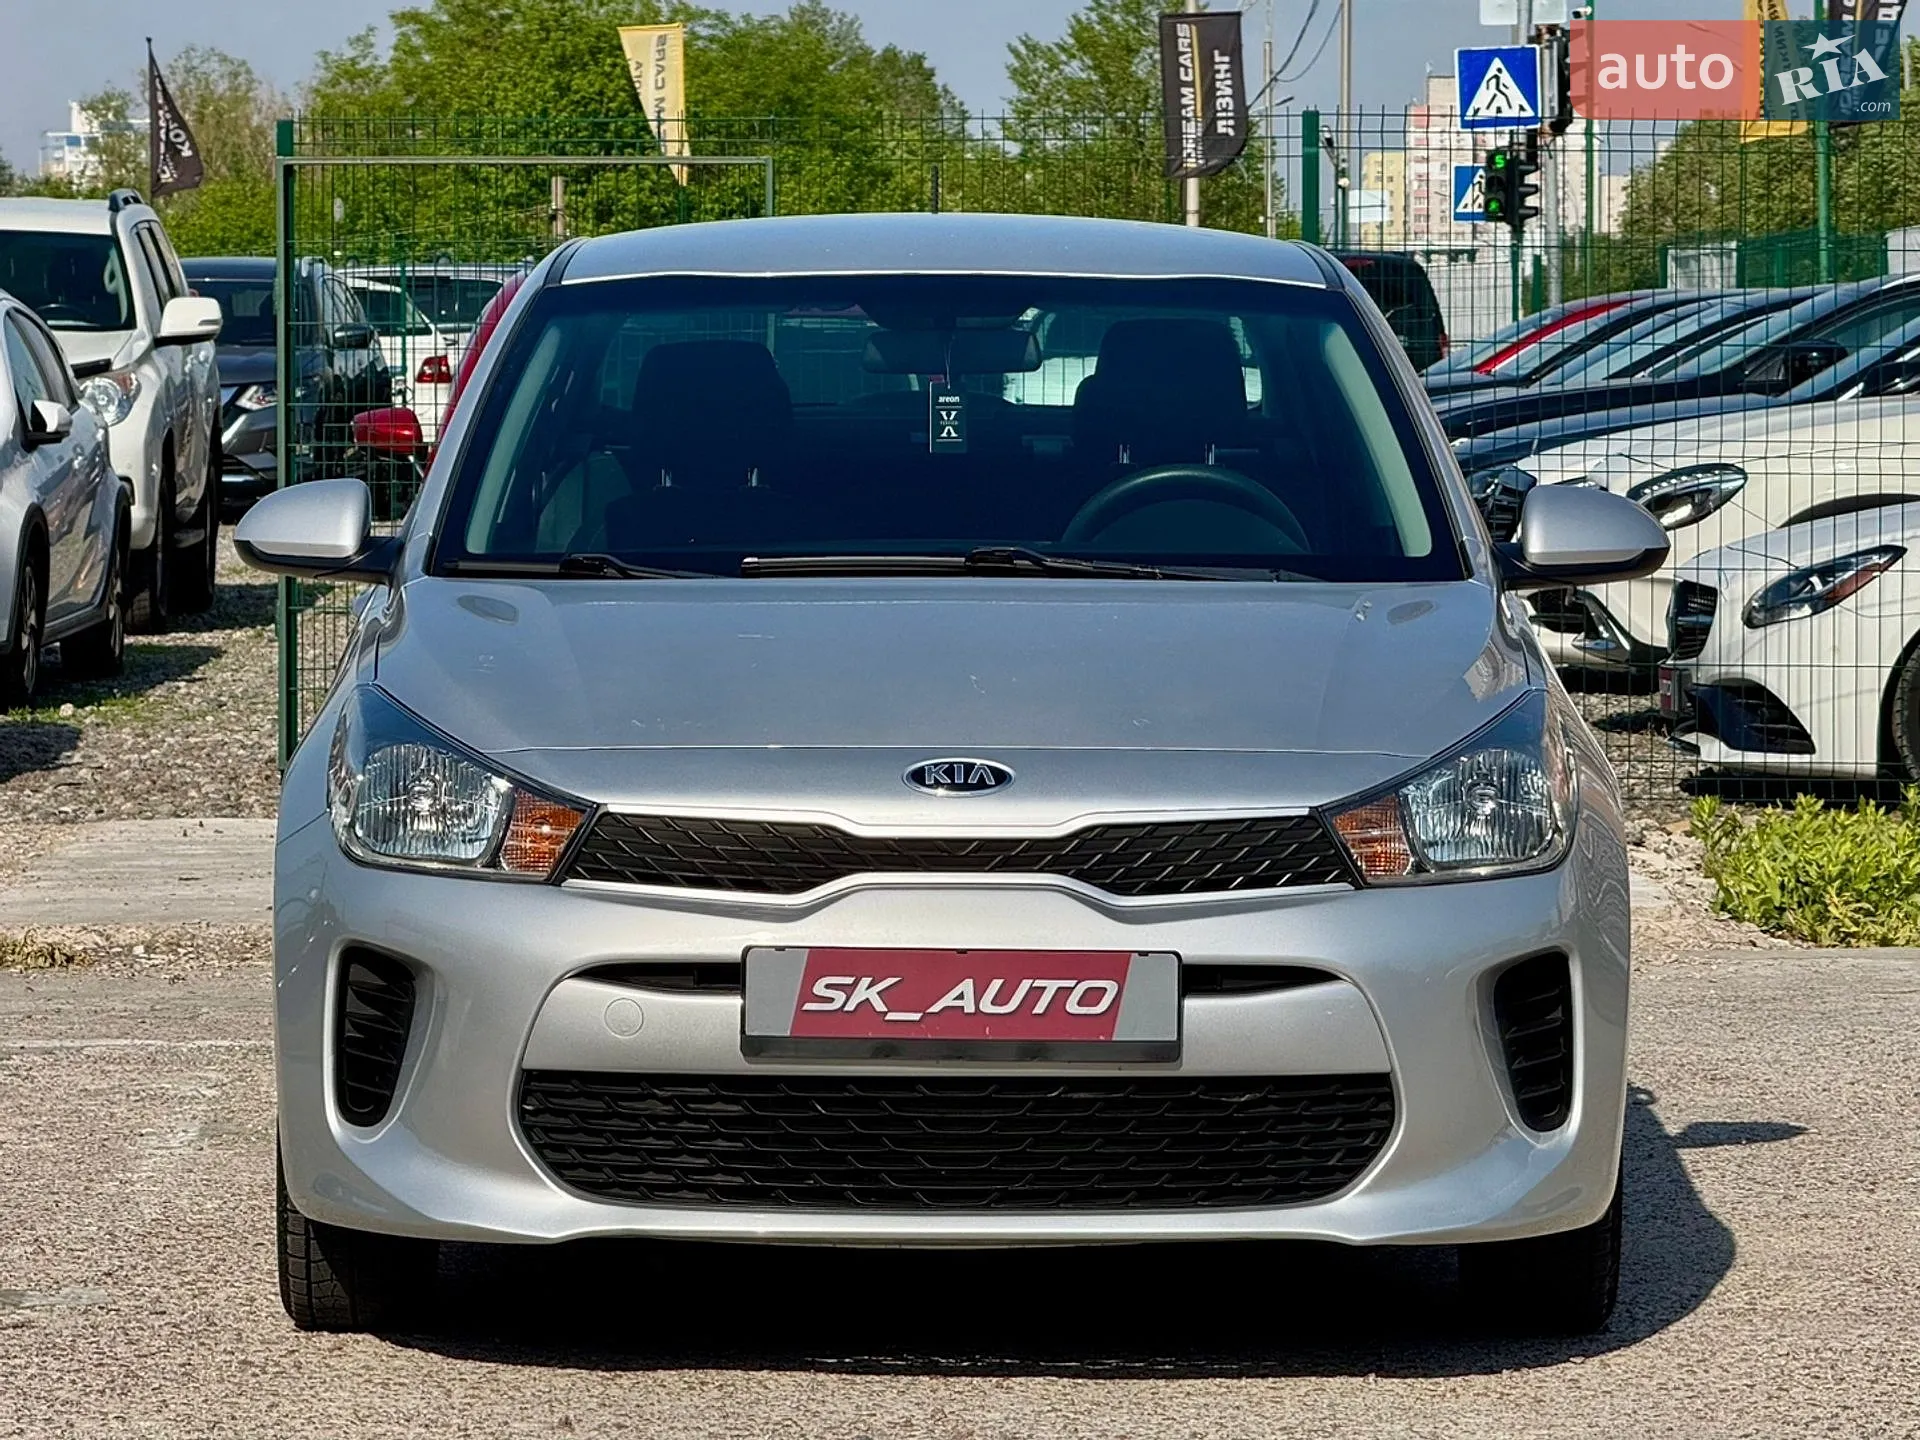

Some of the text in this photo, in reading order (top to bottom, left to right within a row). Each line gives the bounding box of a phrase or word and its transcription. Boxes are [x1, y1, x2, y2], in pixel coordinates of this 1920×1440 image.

[1176, 23, 1193, 82] CARS
[1213, 50, 1235, 136] ЛІЗИНГ
[925, 764, 995, 785] KIA
[801, 976, 1119, 1021] SK_AUTO
